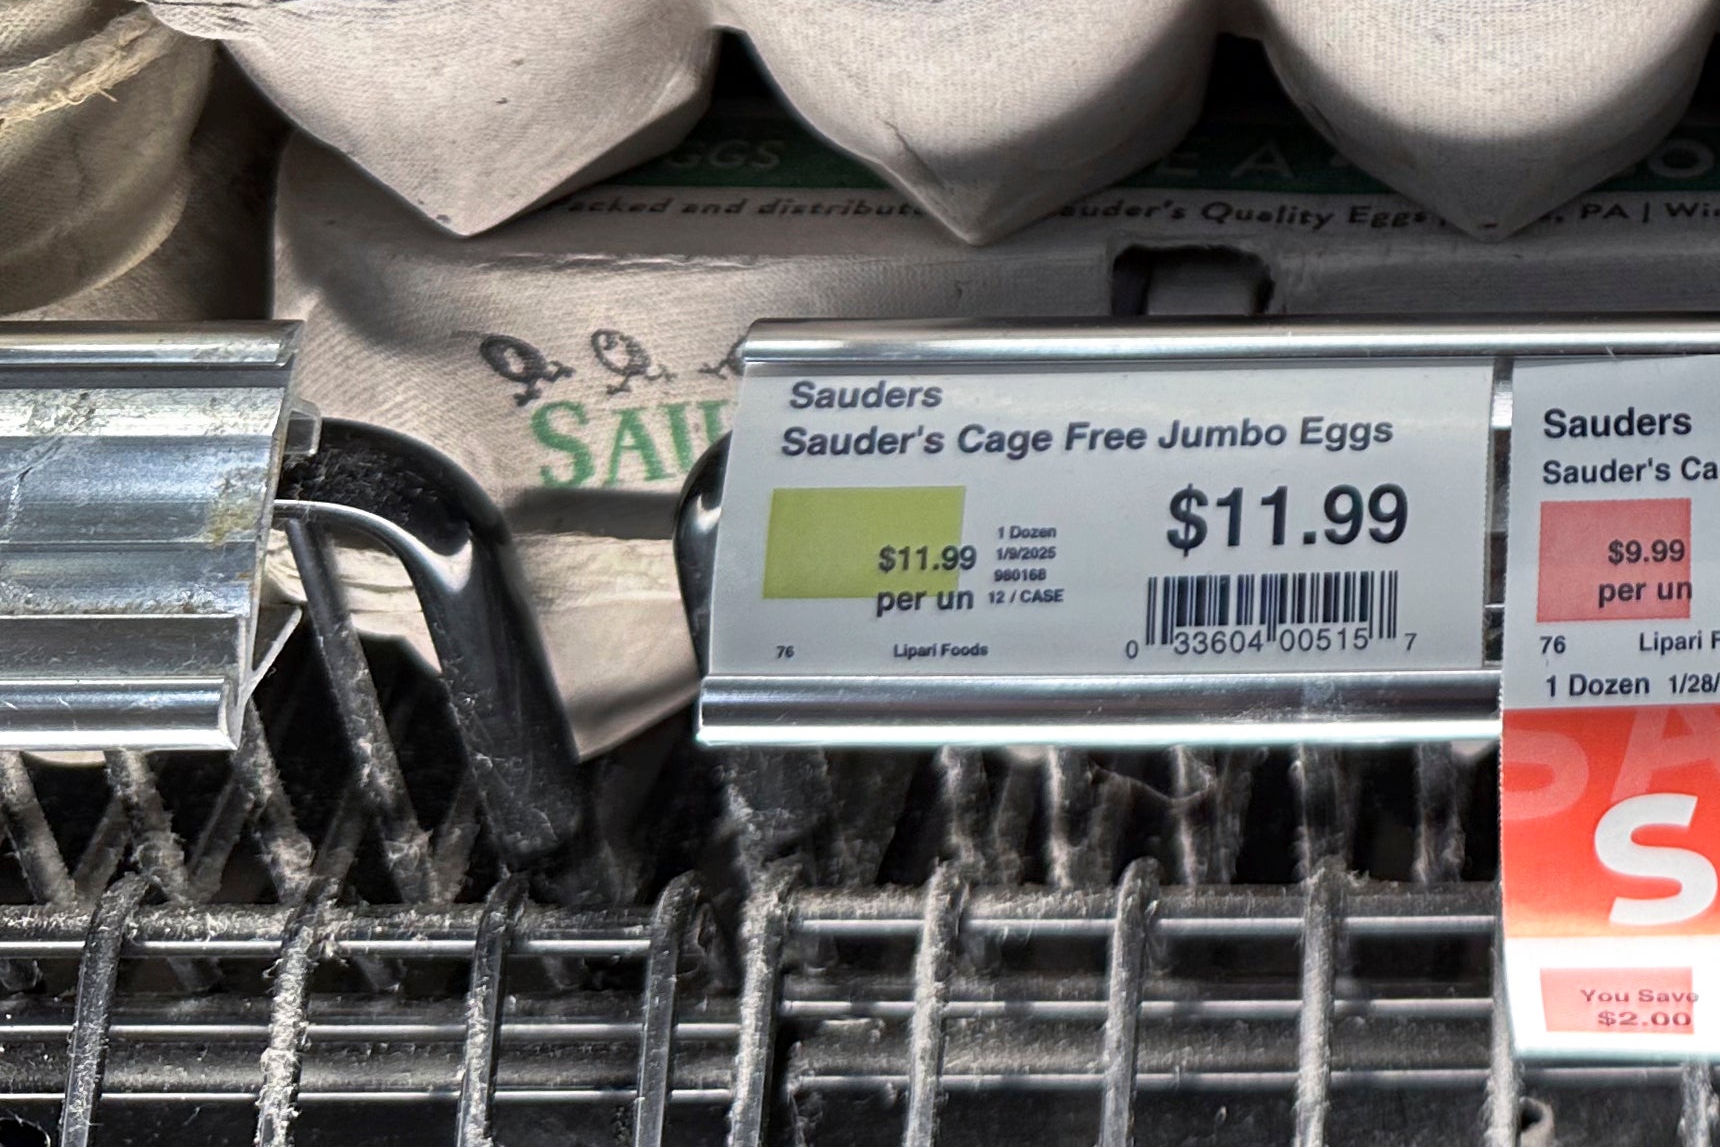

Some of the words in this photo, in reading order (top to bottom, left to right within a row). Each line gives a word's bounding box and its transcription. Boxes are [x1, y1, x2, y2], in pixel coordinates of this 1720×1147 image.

[681, 197, 746, 216] and
[1060, 198, 1188, 221] auder's
[1200, 200, 1334, 229] Quality
[1347, 205, 1429, 229] Eggs
[1578, 203, 1630, 223] PA
[788, 379, 944, 409] Sauders
[1542, 405, 1693, 439] Sauders
[780, 424, 945, 456] Sauder's
[957, 422, 1054, 460] Cage
[1064, 420, 1148, 451] Free
[1157, 417, 1288, 450] Jumbo
[1299, 416, 1394, 452] Eggs
[1542, 456, 1672, 485] Sauder's
[1009, 524, 1058, 540] Dozen
[1166, 482, 1409, 558] $11.99
[878, 544, 978, 573] $11.99
[1608, 538, 1687, 567] $9.99
[876, 589, 928, 617] per
[936, 589, 975, 610] un
[987, 589, 1006, 605] 12
[1019, 587, 1065, 604] CASE
[1597, 581, 1646, 610] per
[1656, 578, 1693, 602] un
[775, 644, 795, 659] 76
[893, 642, 937, 661] Lipari
[940, 642, 989, 657] Foods
[1125, 639, 1140, 659] 0
[1174, 628, 1264, 655] 33604
[1278, 626, 1370, 652] 00515
[1404, 632, 1418, 652] 7
[1539, 634, 1567, 655] 76
[1638, 629, 1703, 657] Lipari
[1546, 675, 1557, 698] 1
[1568, 672, 1651, 697] Dozen
[1579, 988, 1630, 1004] You
[1637, 988, 1700, 1004] Save
[1597, 1009, 1693, 1029] $2.00
